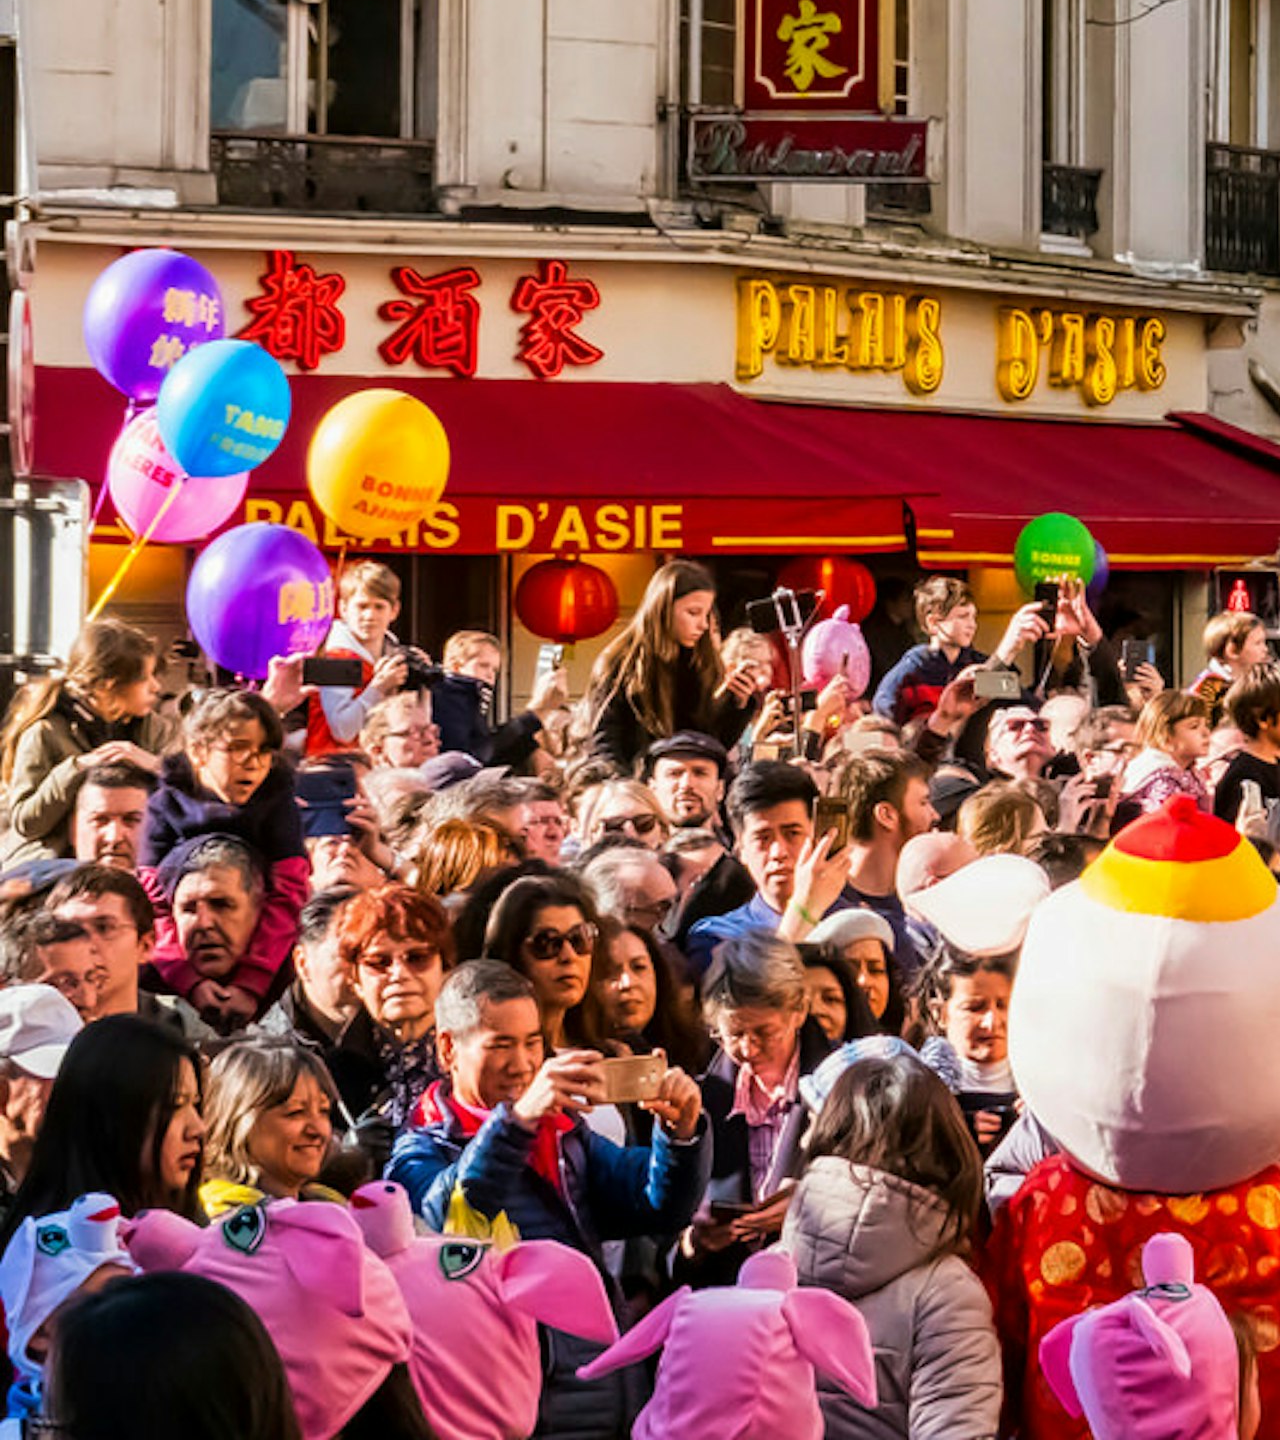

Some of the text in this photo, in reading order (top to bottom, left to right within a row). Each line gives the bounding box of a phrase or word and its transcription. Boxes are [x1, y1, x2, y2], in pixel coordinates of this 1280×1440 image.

[736, 277, 1167, 408] PALAIS D'ASIE
[496, 502, 683, 551] D'ASIE
